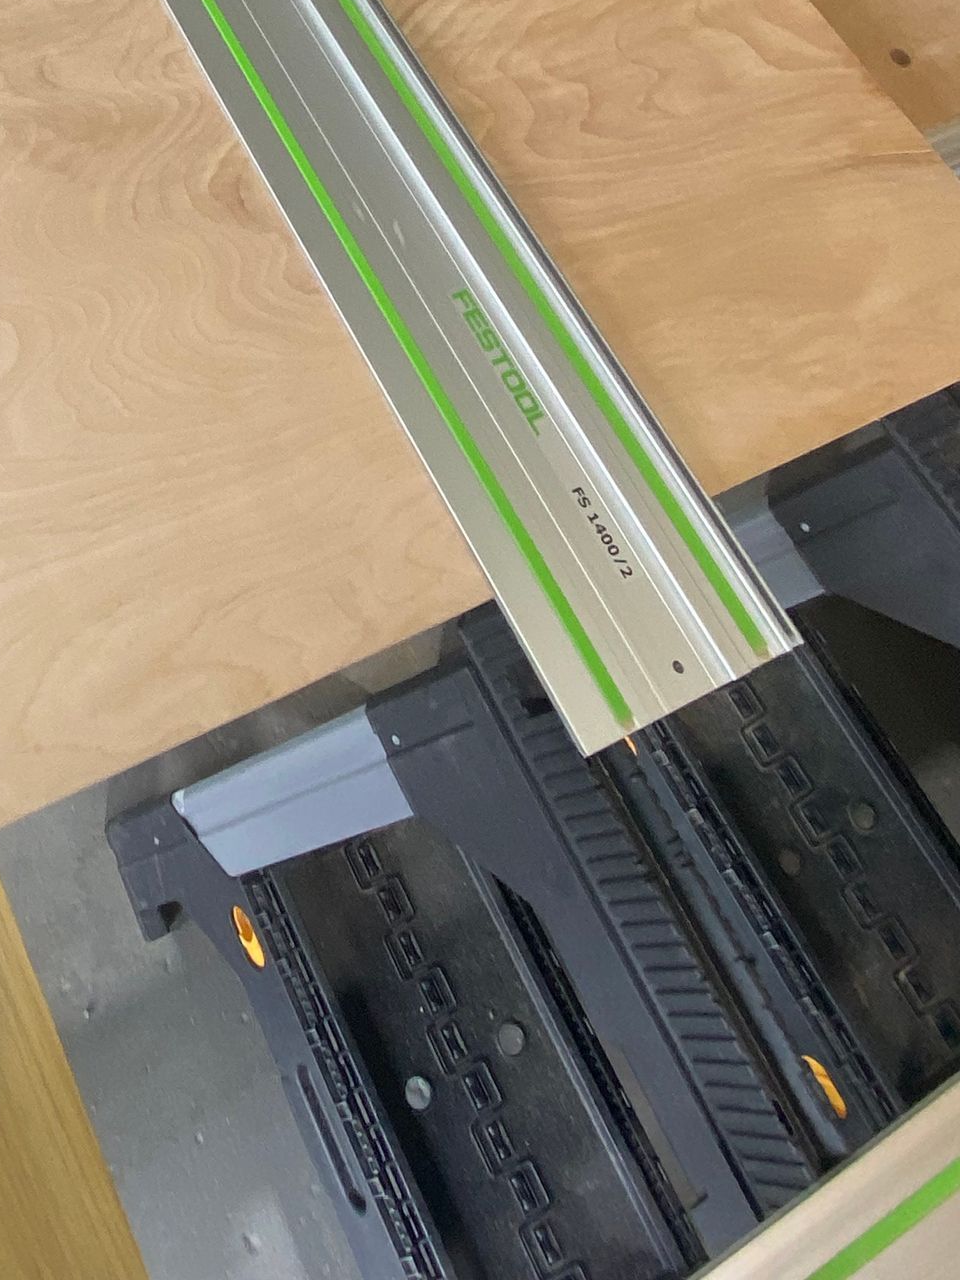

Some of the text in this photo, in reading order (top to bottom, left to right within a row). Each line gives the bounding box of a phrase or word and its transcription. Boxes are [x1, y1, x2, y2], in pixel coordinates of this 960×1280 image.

[451, 287, 545, 437] FESTOOL
[571, 486, 634, 580] FS 1400/2
